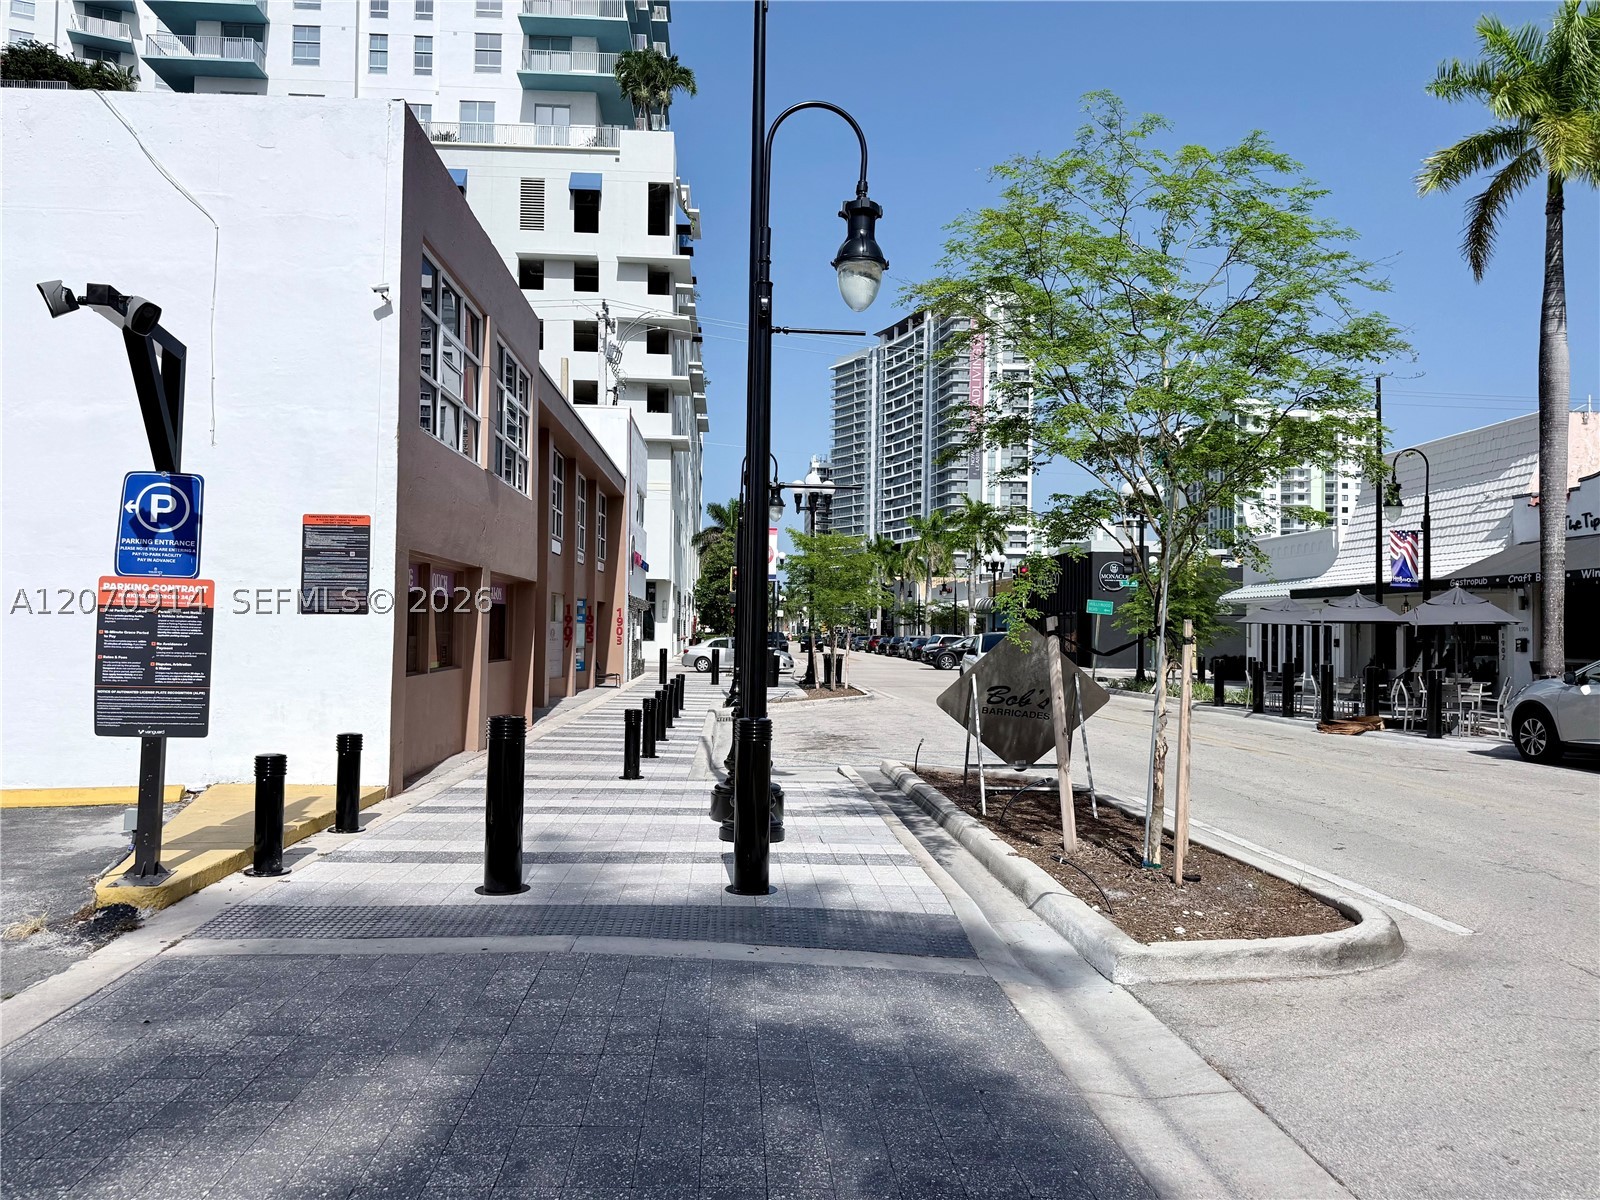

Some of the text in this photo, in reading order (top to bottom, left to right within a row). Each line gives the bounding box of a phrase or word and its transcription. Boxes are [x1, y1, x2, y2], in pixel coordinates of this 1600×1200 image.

[150, 494, 177, 522] P
[154, 539, 196, 547] ENTRANCE
[1449, 577, 1488, 587] Gastropub
[1507, 573, 1532, 584] Craft
[102, 582, 209, 594] PARKING CONTRACT
[563, 603, 573, 648] 1907
[986, 685, 1050, 710] Bob's
[981, 706, 1051, 721] BARRICADES
